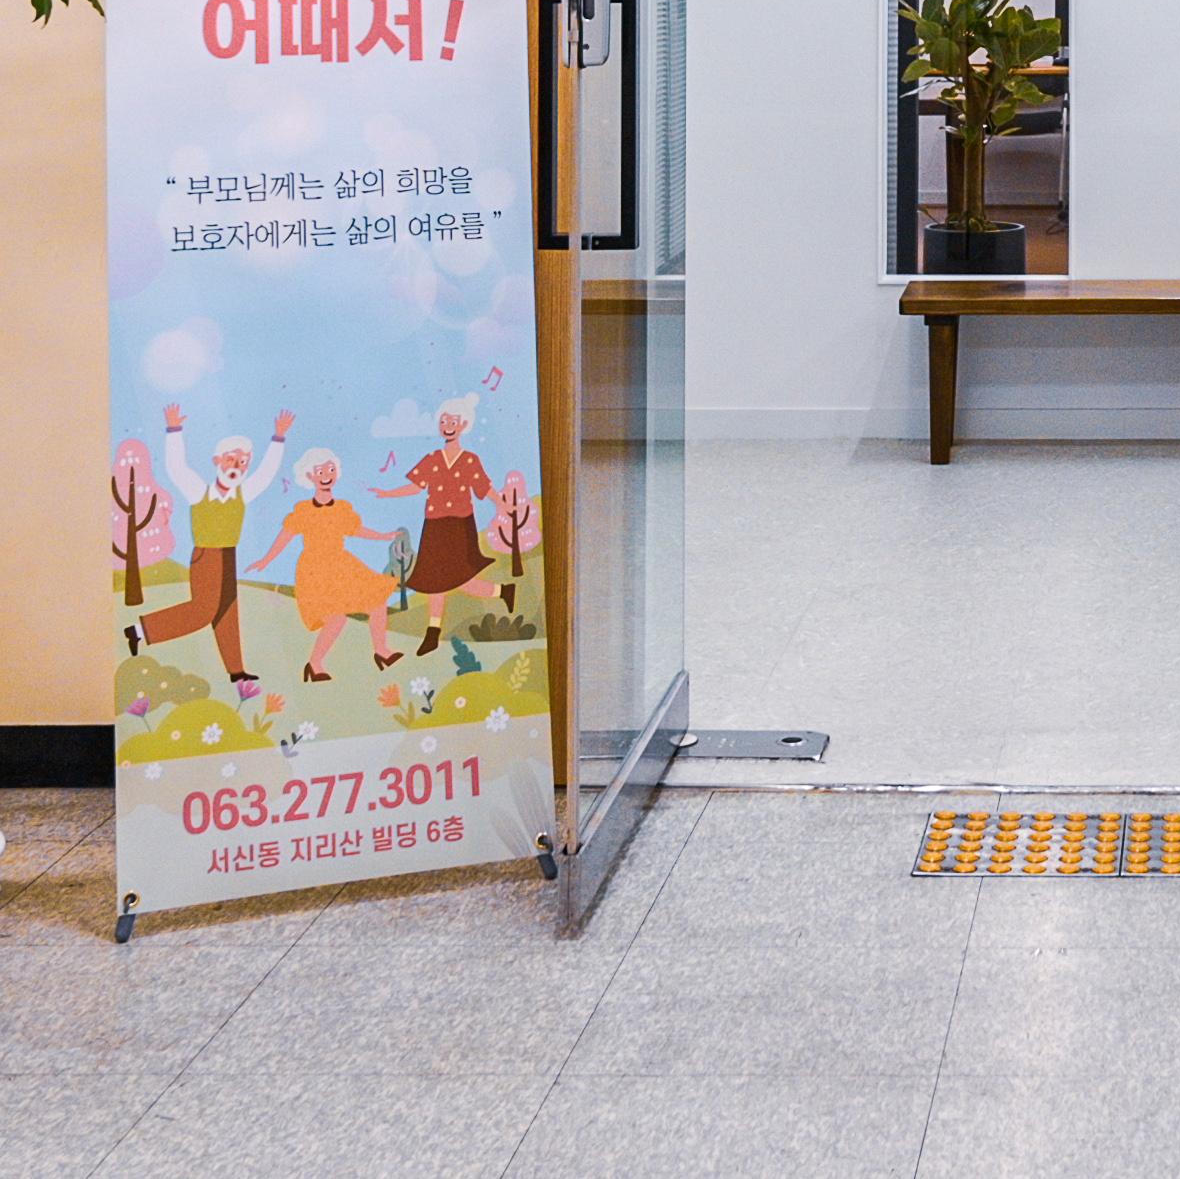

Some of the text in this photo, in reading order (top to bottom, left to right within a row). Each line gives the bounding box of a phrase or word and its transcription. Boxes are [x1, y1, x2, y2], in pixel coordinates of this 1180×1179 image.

[333, 168, 385, 200] 삶의
[396, 165, 473, 196] 희망을
[170, 218, 337, 253] 보호자에게는
[345, 214, 397, 247] 삶의
[181, 755, 481, 835] 063.277.3011
[207, 815, 465, 874] 서신동 지리산 빌딩 6층
